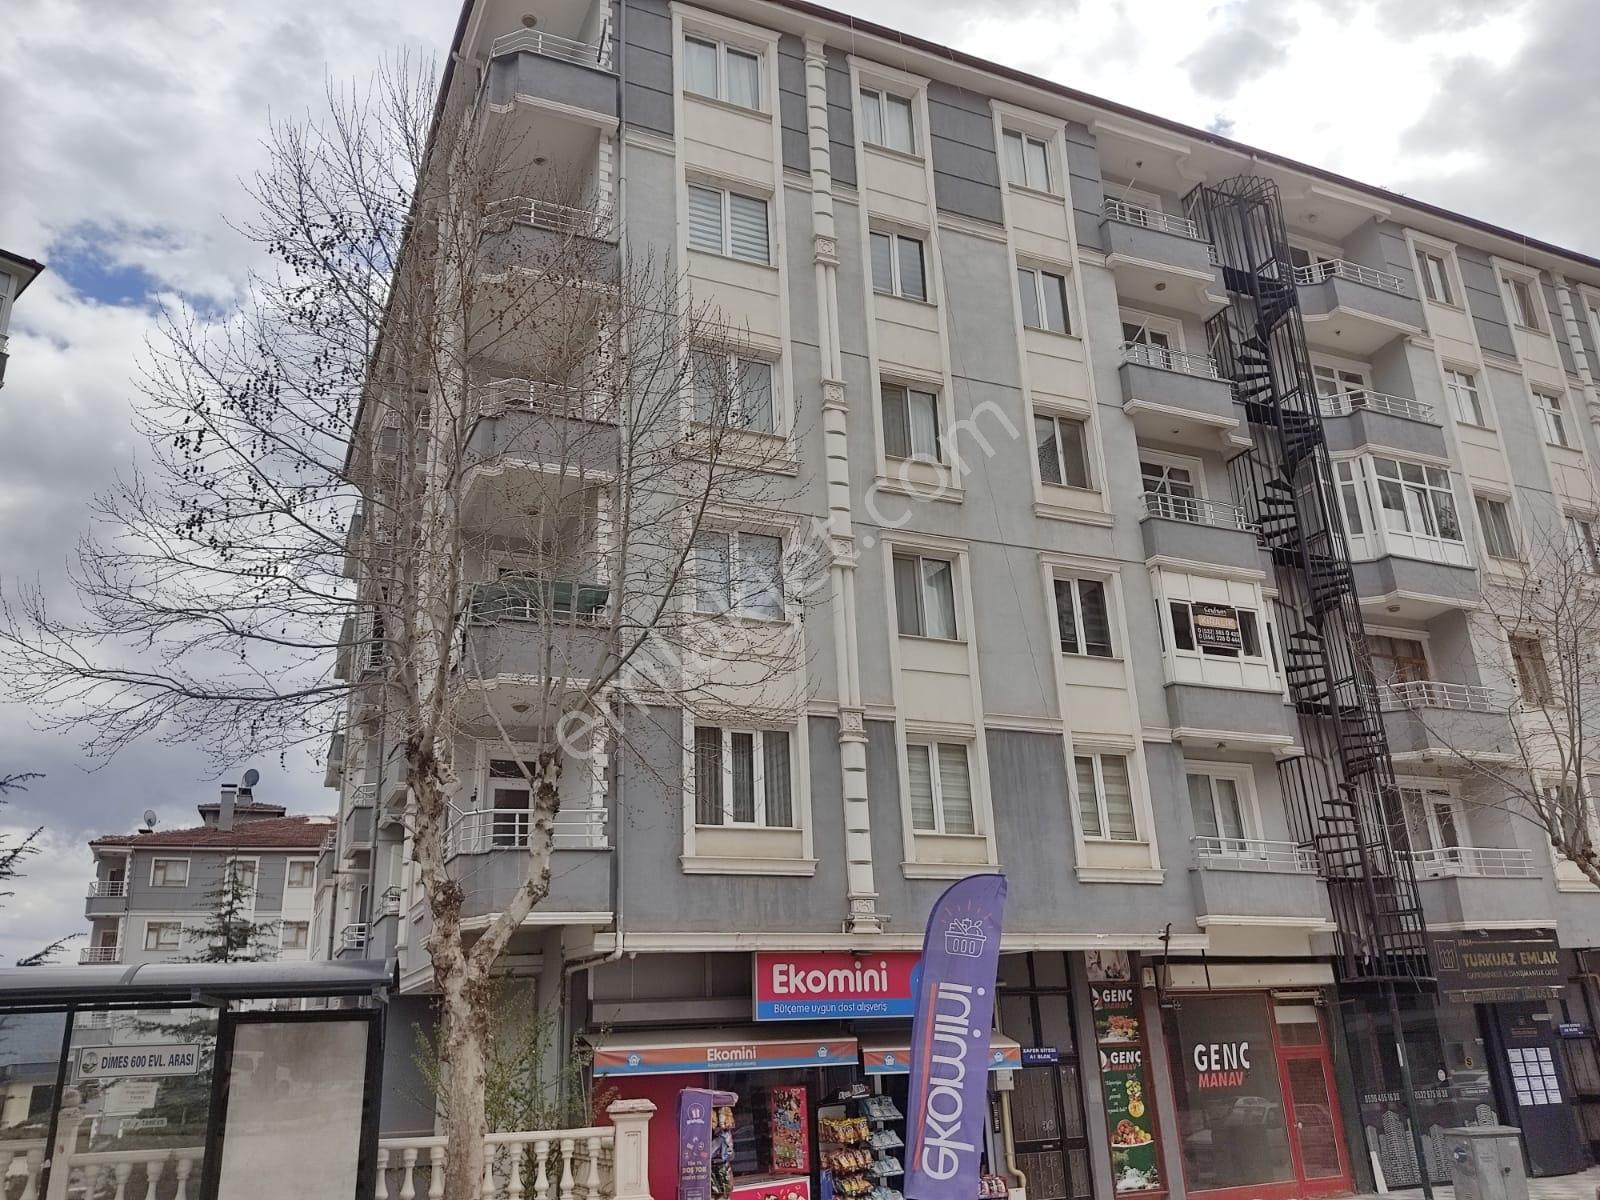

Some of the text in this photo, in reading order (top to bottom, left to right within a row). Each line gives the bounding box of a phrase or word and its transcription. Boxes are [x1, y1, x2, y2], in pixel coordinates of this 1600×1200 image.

[1462, 951, 1559, 968] TURKUAZ EMLAK
[772, 960, 888, 994] Ekomini
[1102, 989, 1132, 1005] GENÇ
[774, 1002, 888, 1015] Bütçeme uygun dost alışveriş
[101, 1053, 194, 1069] DİMES 600 EVL. ARASI
[707, 1046, 756, 1062] Ekomini
[1110, 1050, 1142, 1067] GENÇ
[1198, 1071, 1244, 1088] MANAV
